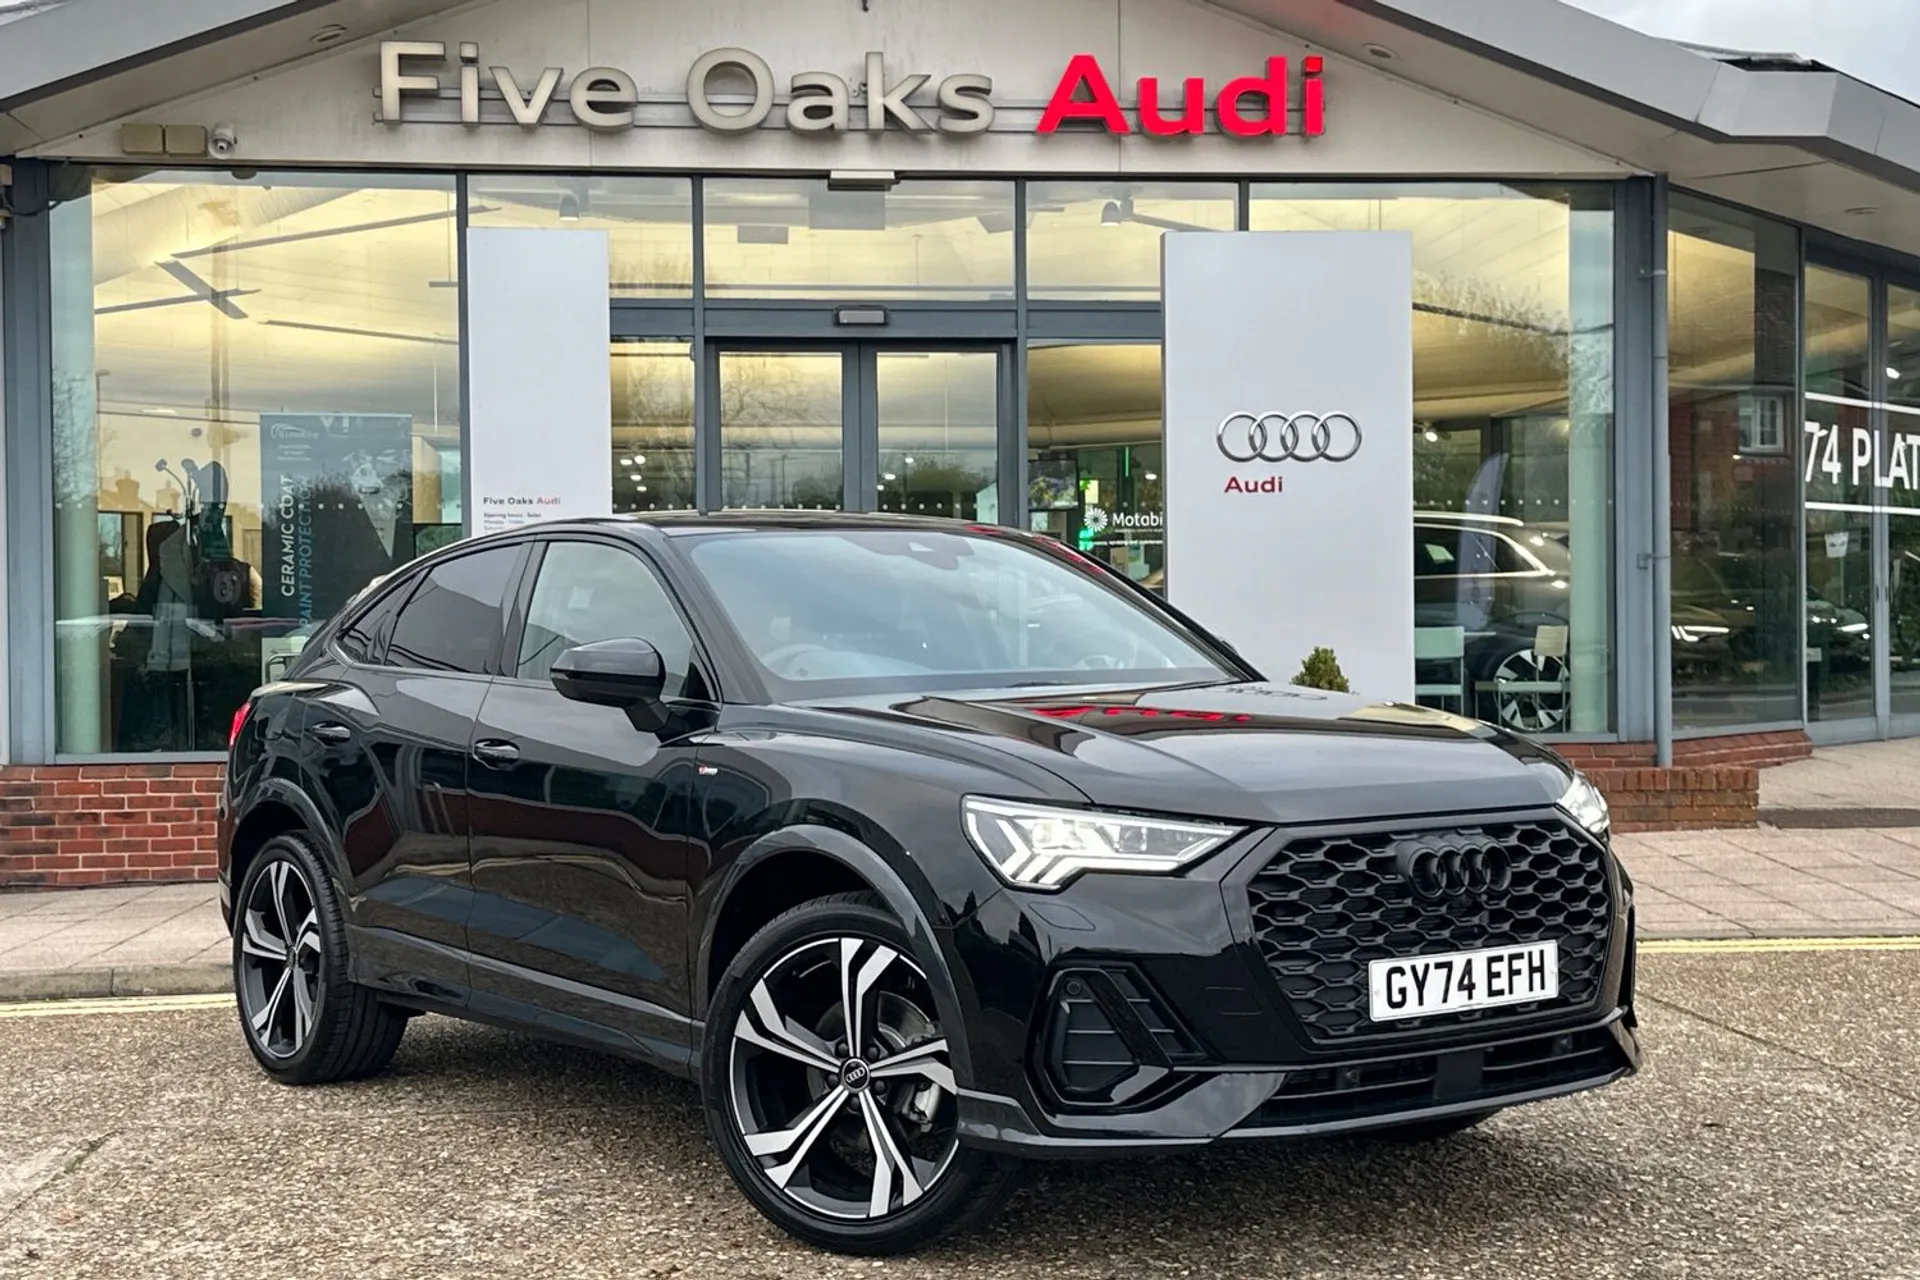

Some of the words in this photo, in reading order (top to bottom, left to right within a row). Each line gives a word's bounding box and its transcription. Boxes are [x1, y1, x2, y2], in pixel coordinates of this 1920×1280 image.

[379, 40, 638, 133] Five
[686, 46, 996, 137] Oaks
[1036, 53, 1325, 137] Audi
[1804, 420, 1842, 485] 74
[1852, 427, 1920, 491] PLAT
[280, 474, 295, 519] COAT
[483, 496, 505, 505] Five
[507, 496, 534, 505] Oaks
[536, 496, 562, 505] Audi
[1224, 476, 1284, 493] Audi
[280, 523, 295, 597] CERAMIC
[299, 582, 313, 628] PAINT
[1386, 958, 1476, 1010] GY74
[1487, 949, 1546, 998] EFH
